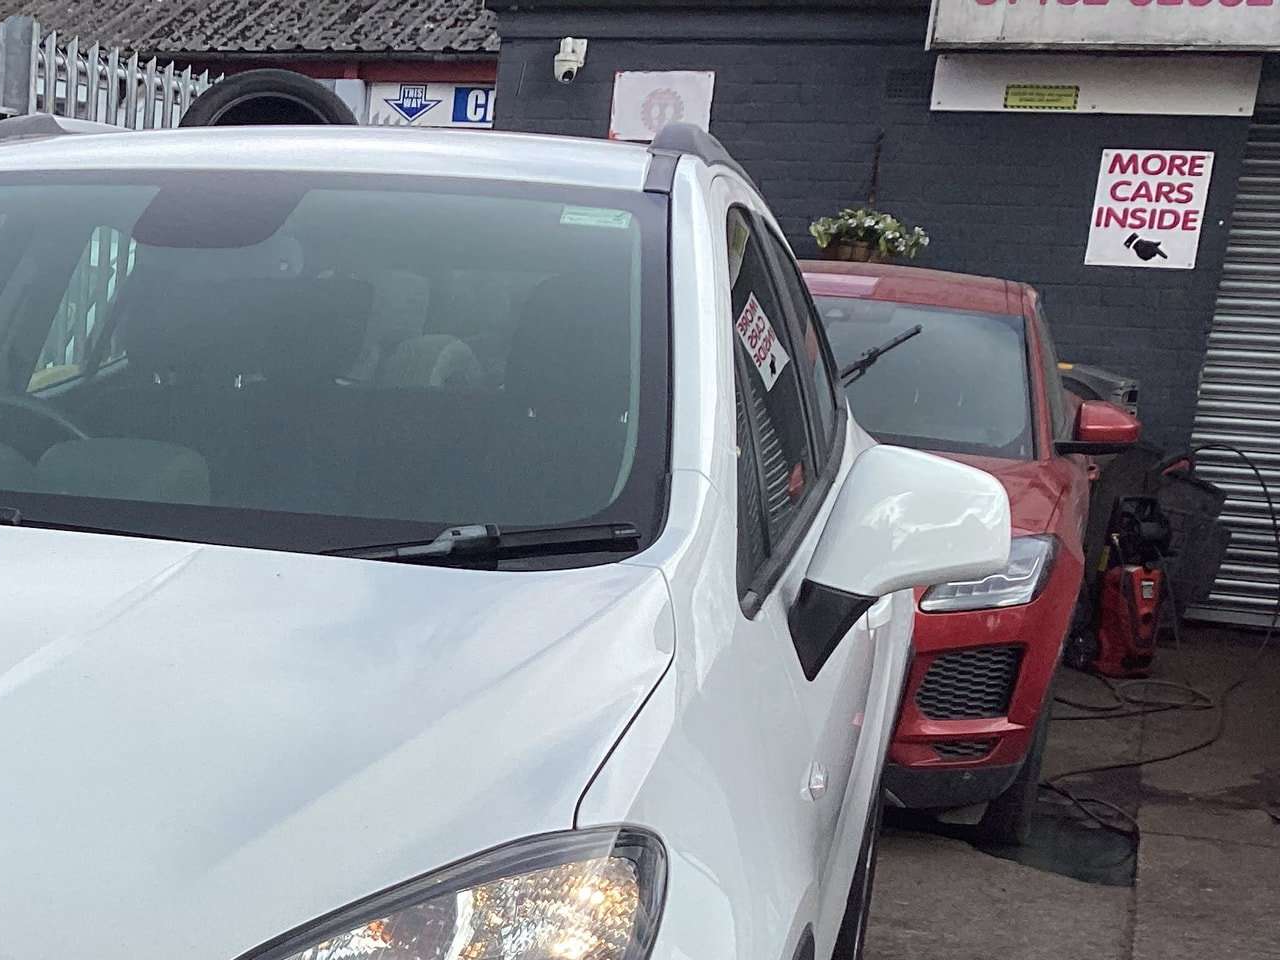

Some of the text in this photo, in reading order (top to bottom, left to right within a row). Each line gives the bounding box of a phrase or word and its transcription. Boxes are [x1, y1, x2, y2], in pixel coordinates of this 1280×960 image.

[403, 98, 422, 108] WAY
[404, 88, 423, 98] THIS
[1108, 153, 1206, 177] MORE
[1109, 180, 1194, 204] CARS
[1095, 206, 1200, 231] INSIDE
